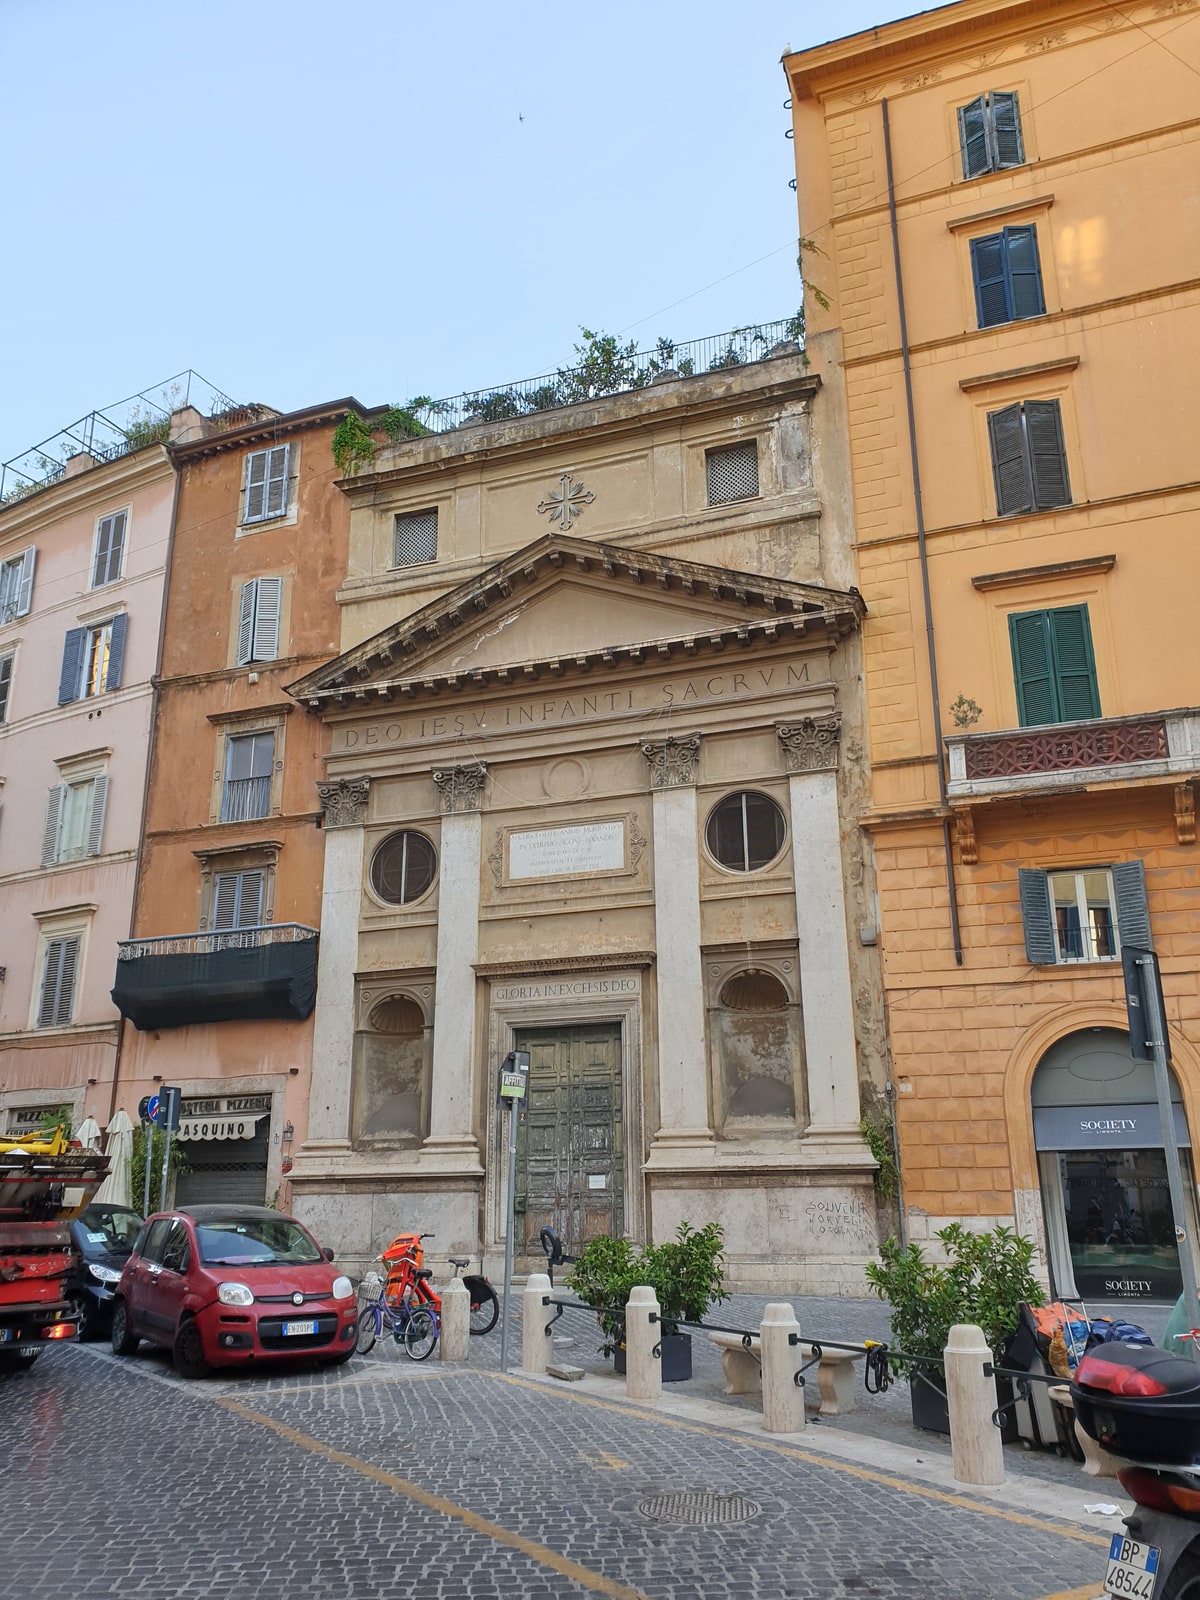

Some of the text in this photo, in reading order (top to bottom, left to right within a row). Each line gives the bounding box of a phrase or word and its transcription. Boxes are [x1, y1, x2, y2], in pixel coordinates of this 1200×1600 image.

[345, 662, 811, 748] DEO IESV INFANTI SACRVM
[496, 986, 541, 1000] GLORIA
[611, 979, 636, 992] DEO
[1080, 1119, 1137, 1130] SOCIETY
[1105, 1280, 1152, 1291] SOCIETY
[1121, 1540, 1140, 1563] BP
[1107, 1566, 1152, 1600] 48544
